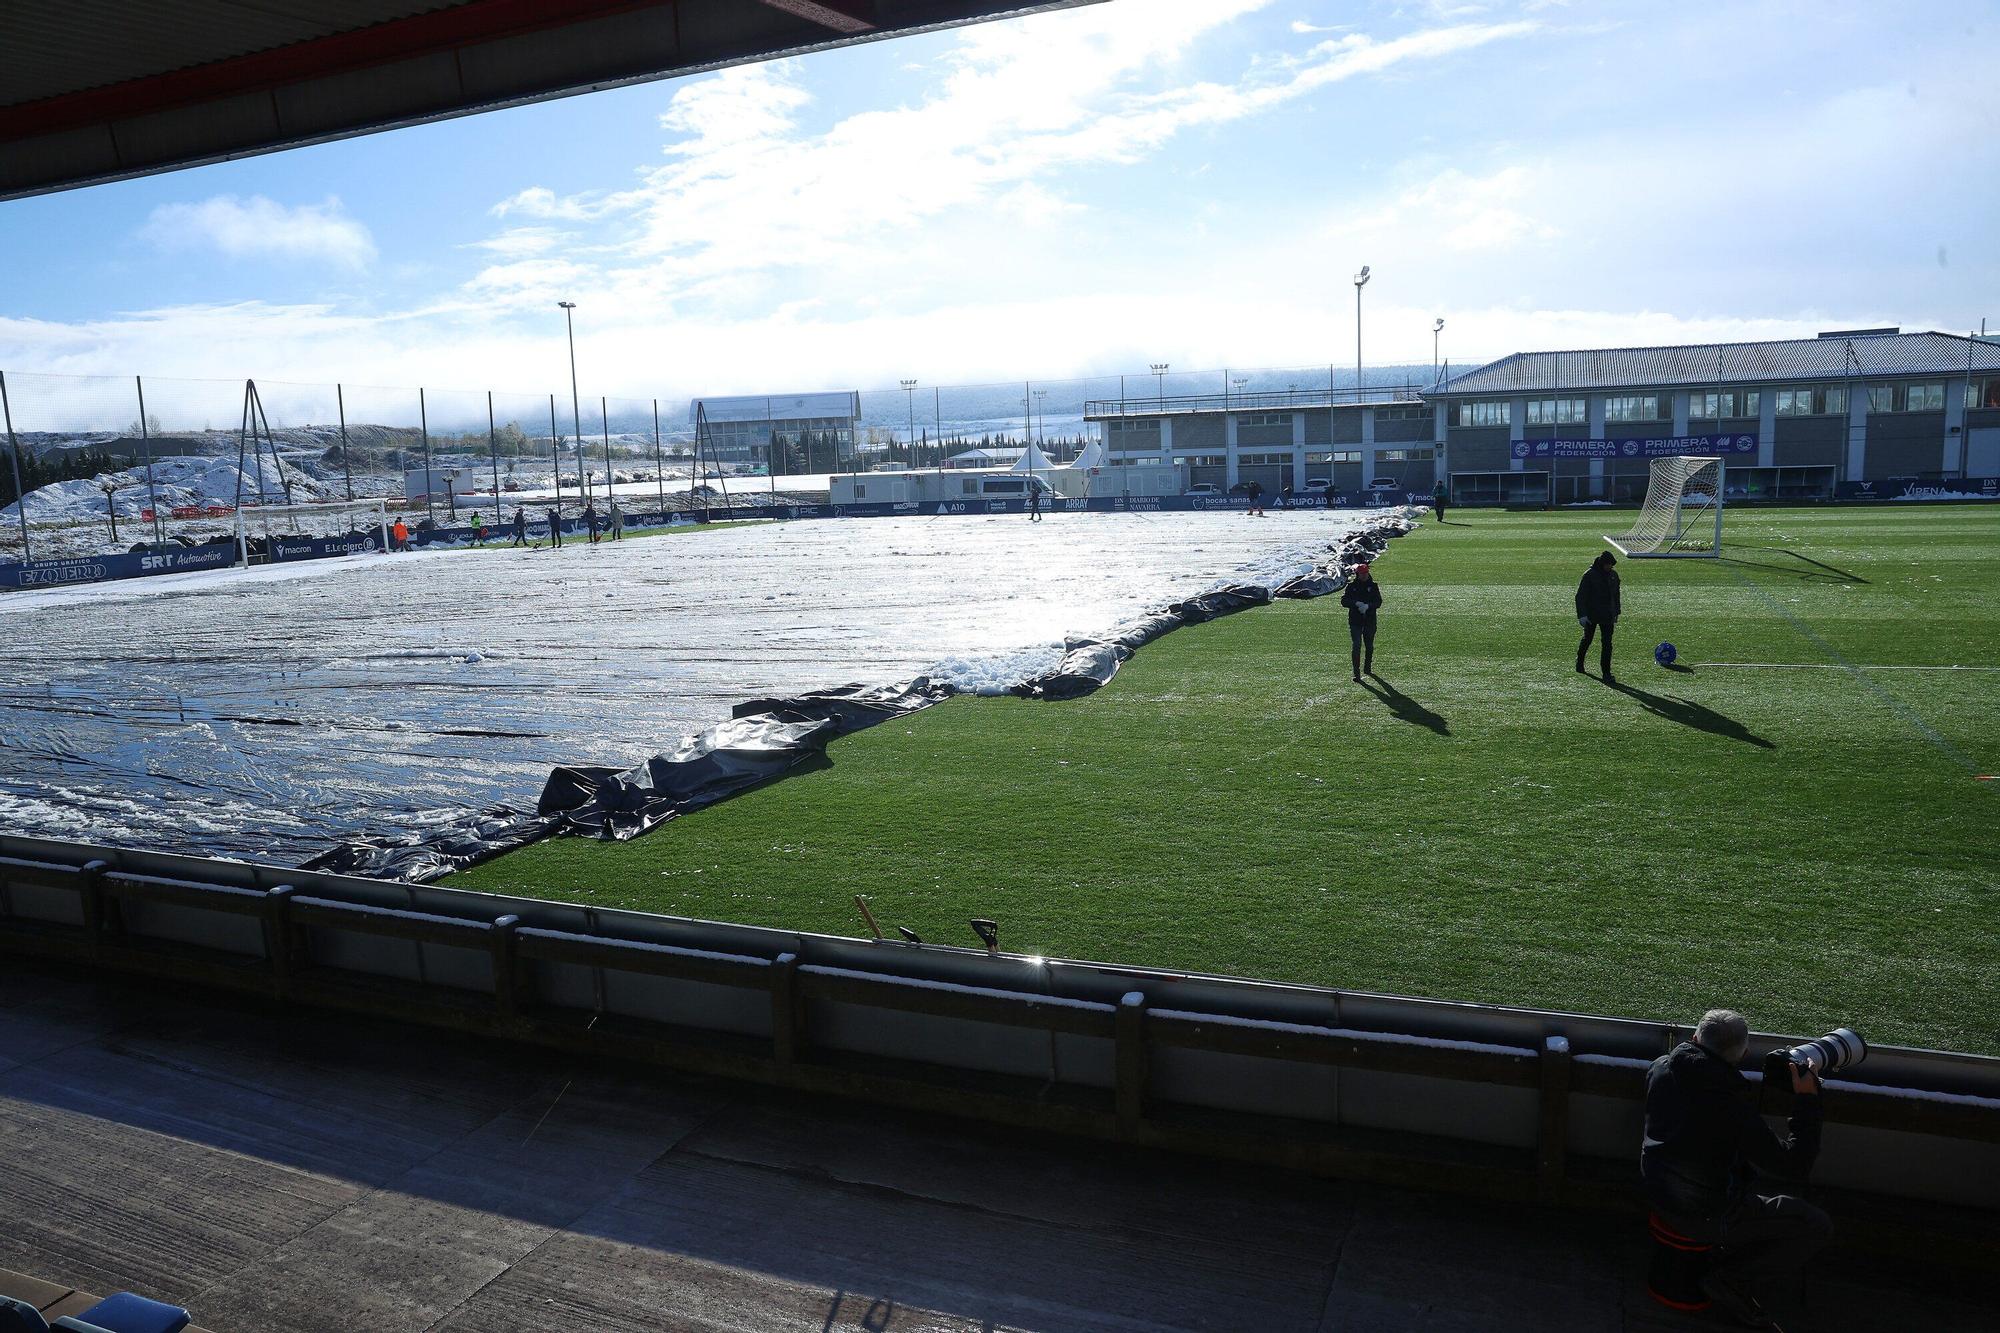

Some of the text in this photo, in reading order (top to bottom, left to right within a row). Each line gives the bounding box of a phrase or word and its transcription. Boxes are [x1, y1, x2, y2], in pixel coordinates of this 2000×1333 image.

[1554, 440, 1616, 450] PRIMERA
[1644, 437, 1709, 449] PRIMERA
[1645, 446, 1710, 455] FEDERACIÓN
[1983, 479, 1997, 487] DN
[1903, 482, 1946, 495] VIRENA
[951, 503, 966, 511] A10
[1065, 498, 1088, 509] ARRAY
[1129, 503, 1160, 511] NAVARRA
[284, 545, 312, 554] macron
[141, 551, 223, 570] SRT Automotive
[19, 564, 107, 586] EZQUERRO
